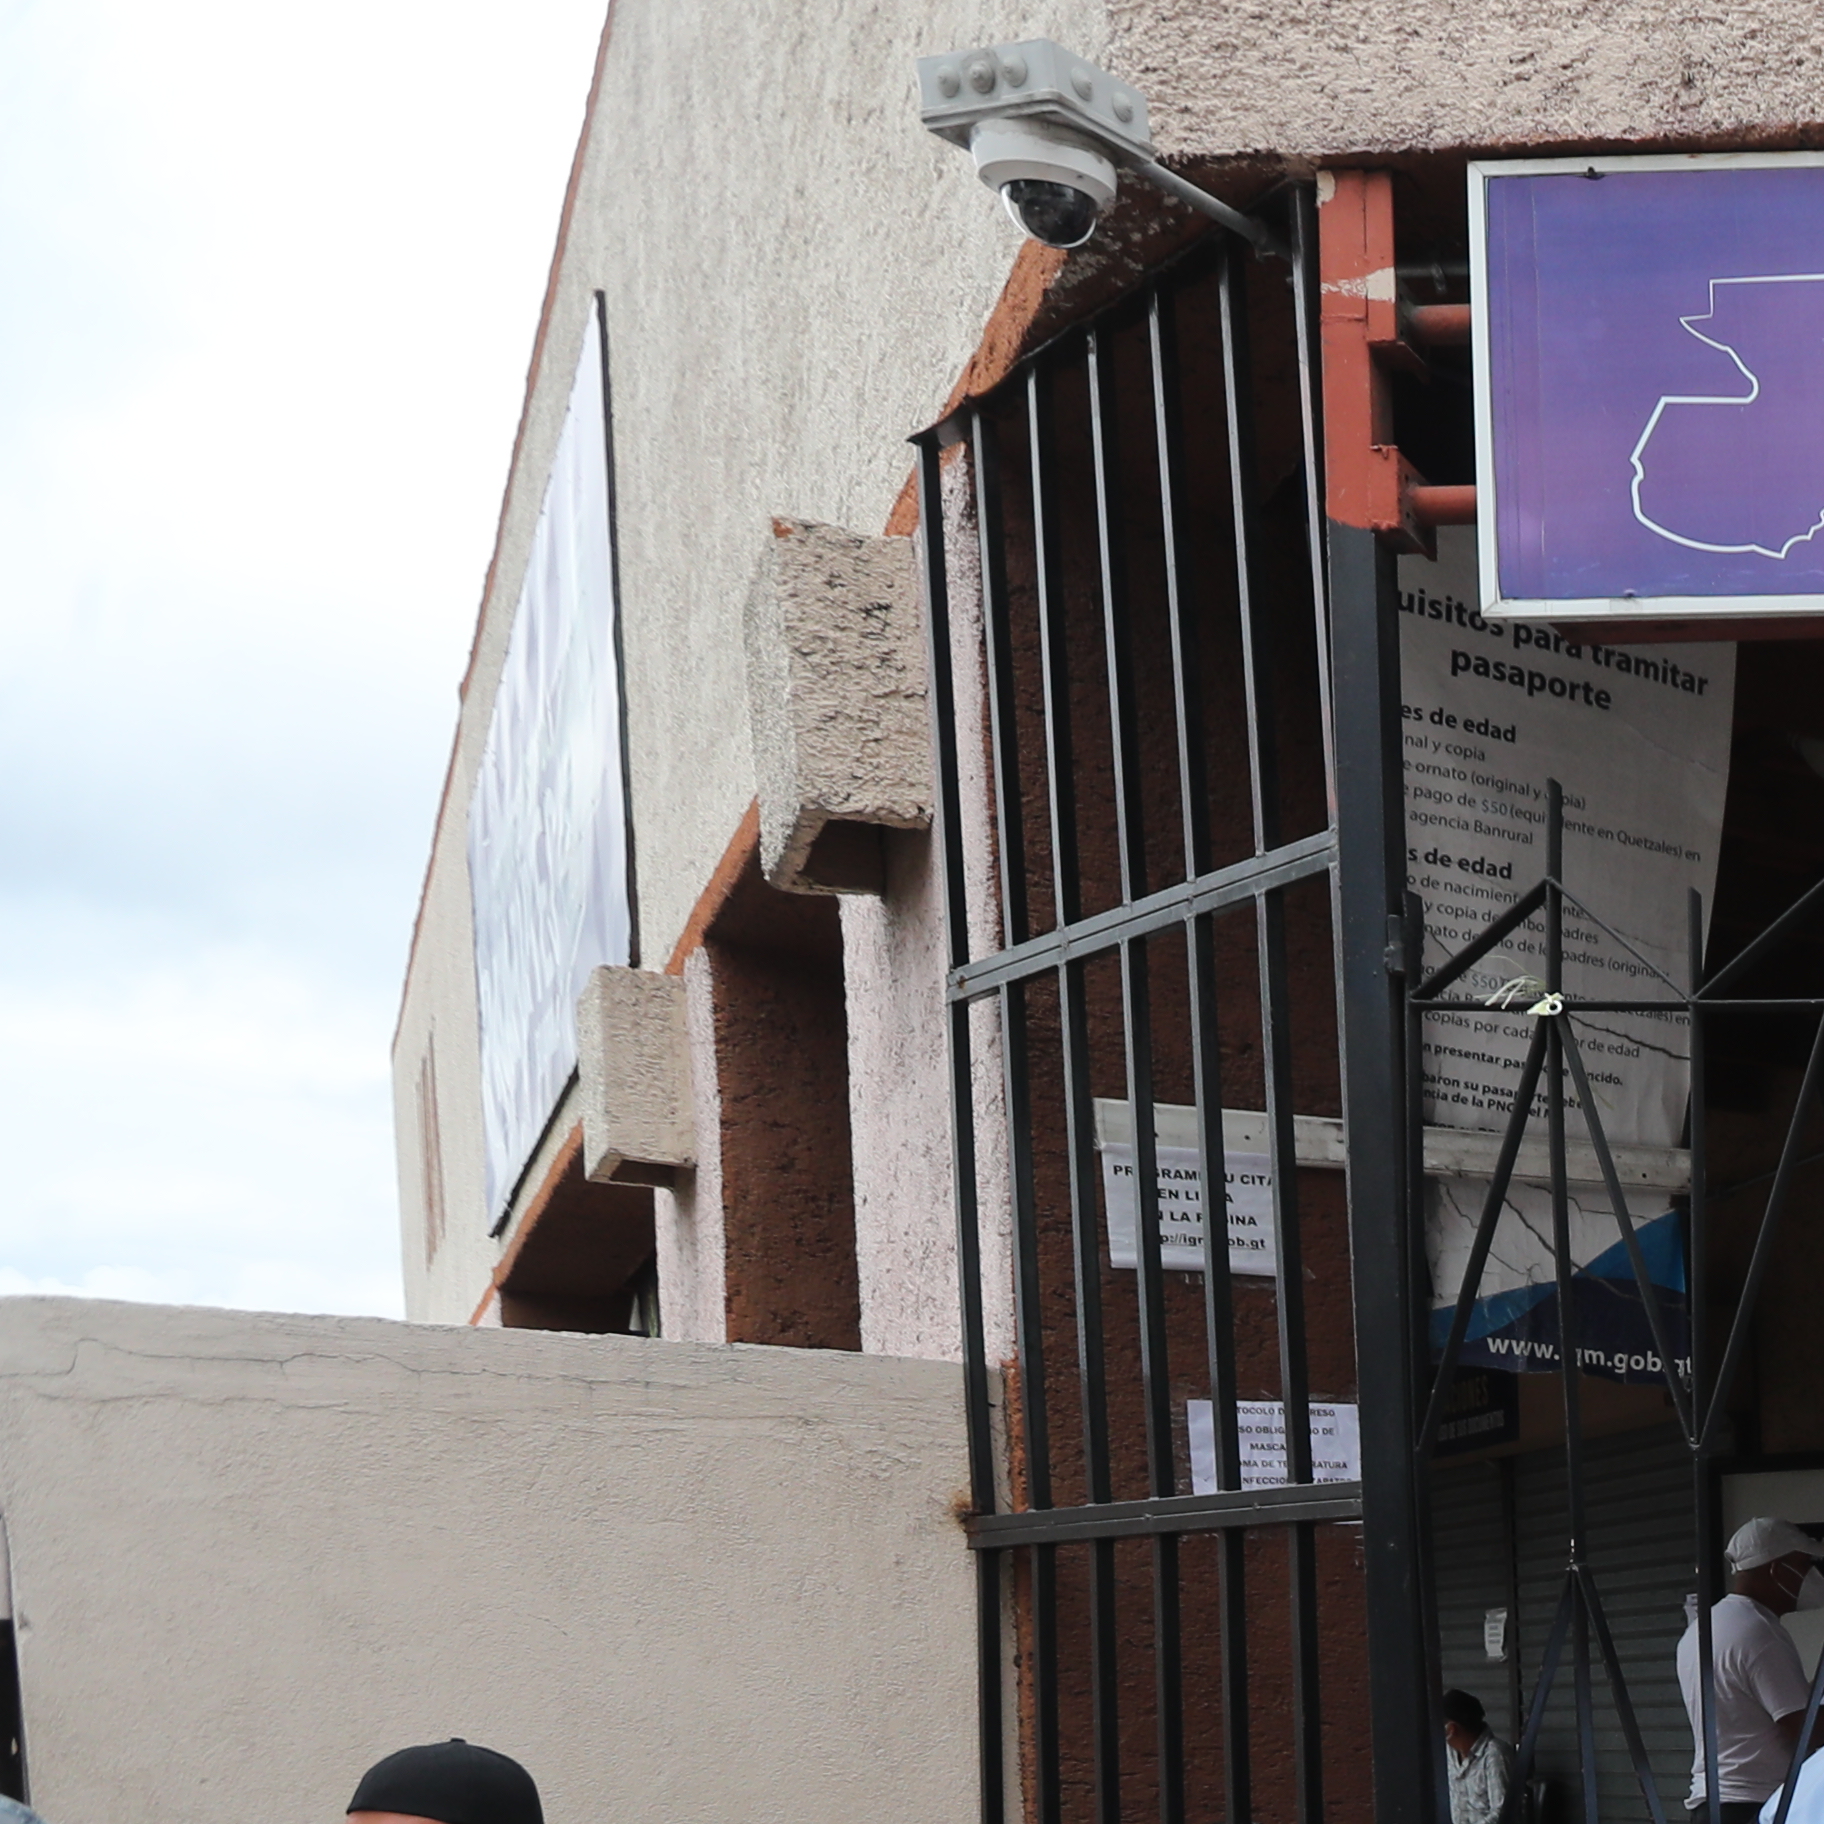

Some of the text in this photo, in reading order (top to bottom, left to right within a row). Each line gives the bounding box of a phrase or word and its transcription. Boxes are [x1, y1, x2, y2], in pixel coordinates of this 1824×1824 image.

[1398, 589, 1709, 696] uisitos para tramitar
[1451, 648, 1612, 711] pasaporte
[1429, 707, 1517, 744] de edad
[1432, 741, 1486, 763] y copia
[1415, 763, 1468, 782] ornato
[1470, 771, 1530, 797] (original
[1409, 810, 1534, 845] agencia Banrural
[1413, 786, 1701, 862] pago de $50 en Quetzales) en
[1424, 850, 1513, 880] de edad
[1420, 875, 1520, 906] de nacimient
[1437, 902, 1478, 921] copia
[1481, 909, 1500, 923] de
[1517, 940, 1535, 954] de
[1472, 973, 1497, 991] $50
[1425, 1010, 1641, 1059] copias por de edad
[1434, 1043, 1500, 1068] presentar
[1463, 1081, 1479, 1092] su
[1451, 1092, 1515, 1113] de la PNC
[1170, 1211, 1191, 1223] LA
